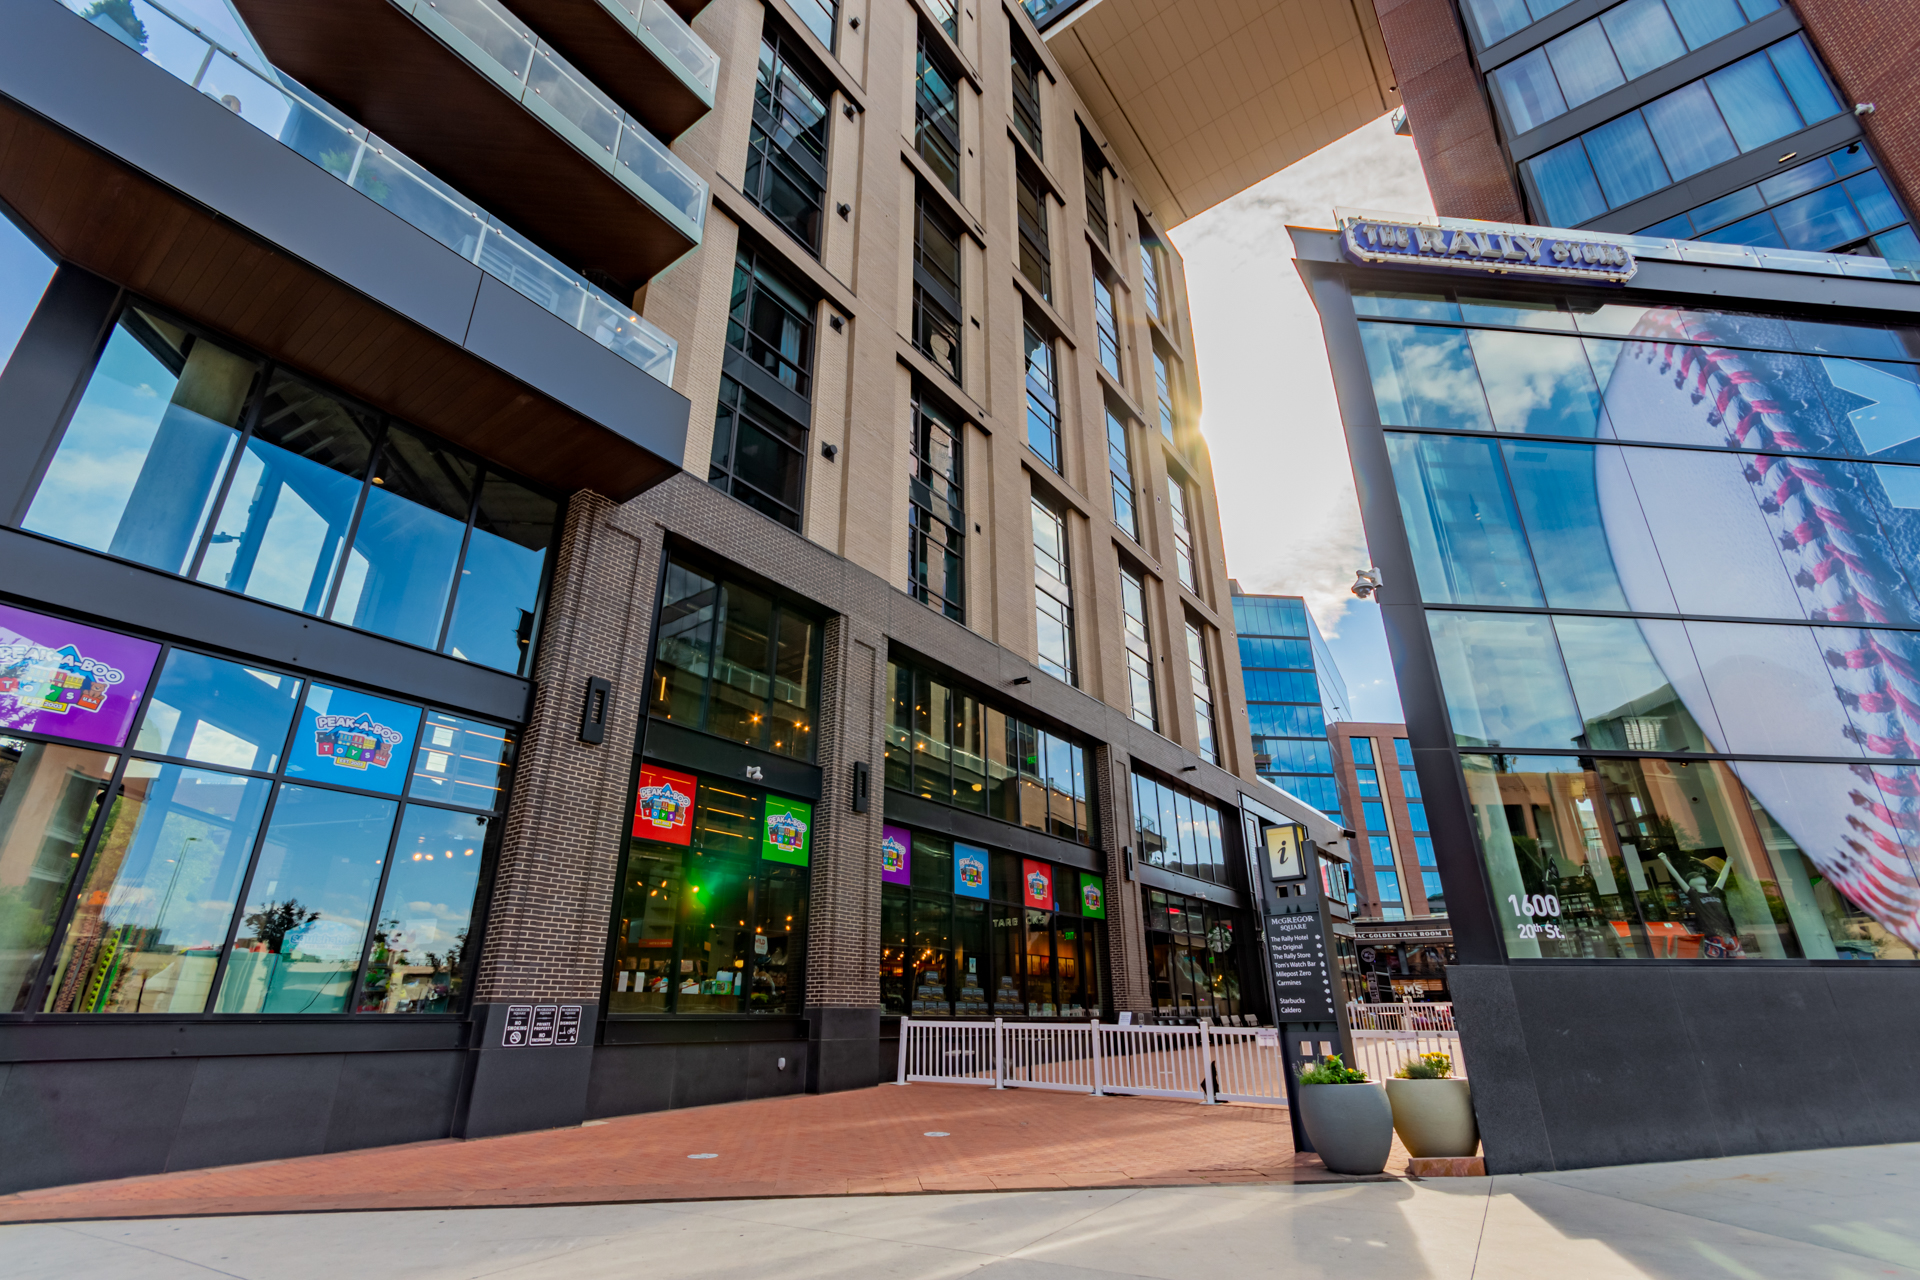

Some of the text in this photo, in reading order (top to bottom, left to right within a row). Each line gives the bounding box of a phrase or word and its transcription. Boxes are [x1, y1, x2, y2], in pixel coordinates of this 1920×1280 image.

[1363, 225, 1629, 266] THE RALLY STORE
[1, 645, 123, 684] PEAK-A-BOO
[318, 717, 402, 743] PEAK-A-BOO
[323, 744, 371, 759] TOYS
[641, 788, 690, 807] PEAK-A-BOO
[1508, 894, 1561, 917] 1600
[1271, 915, 1315, 925] McGREGOR
[1280, 923, 1307, 932] SQUARE
[1517, 923, 1566, 939] 20th St.
[1282, 943, 1303, 951] Original
[1284, 952, 1296, 960] Rally
